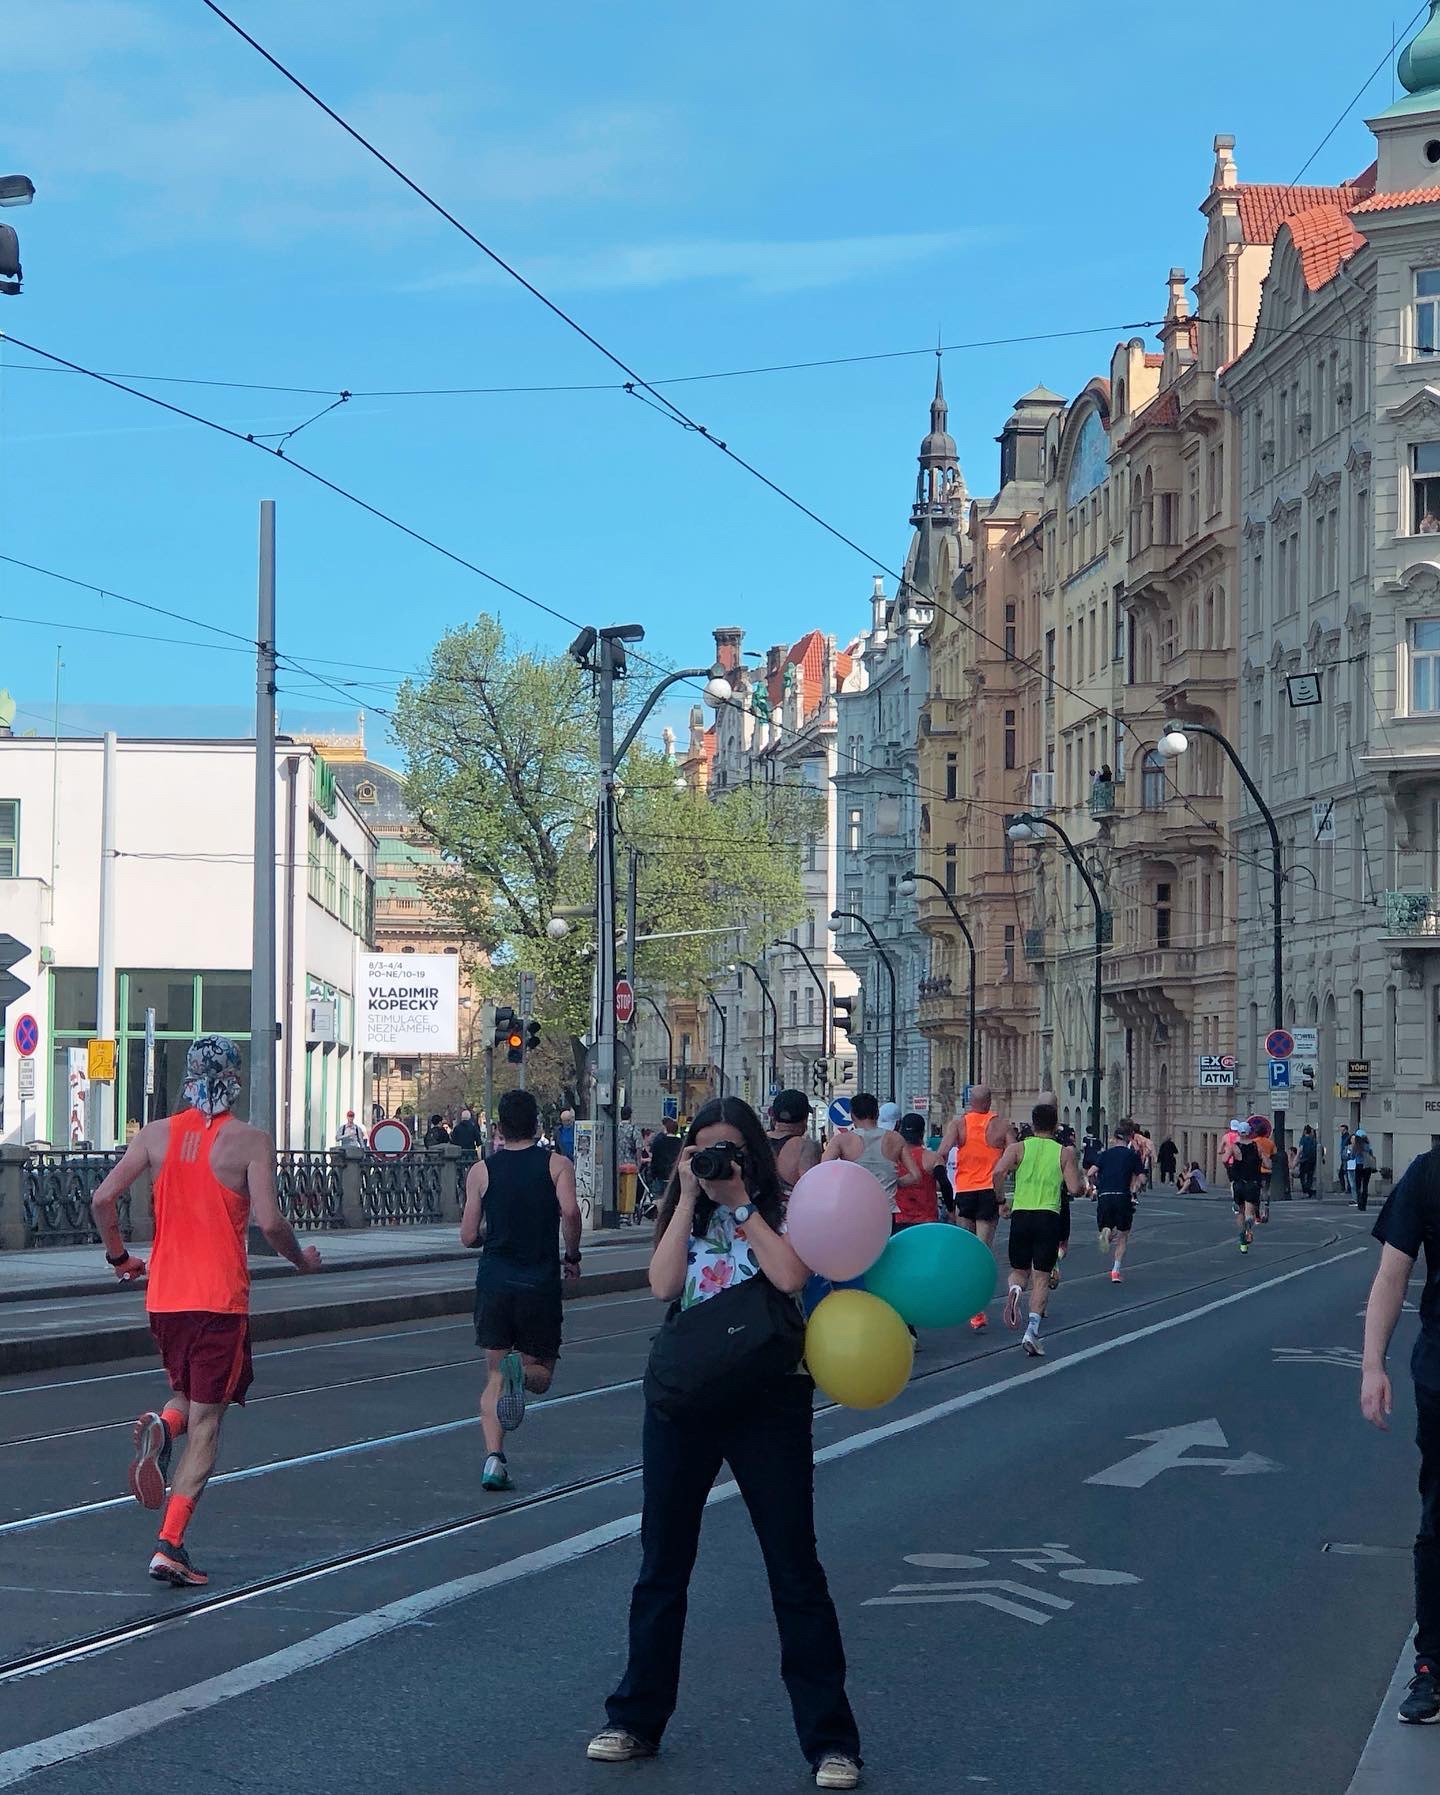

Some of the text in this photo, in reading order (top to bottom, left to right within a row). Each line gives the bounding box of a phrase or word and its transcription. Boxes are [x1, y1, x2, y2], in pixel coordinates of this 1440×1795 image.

[616, 994, 631, 1009] STOP
[368, 1014, 429, 1024] STIMULACE
[368, 1033, 397, 1043] POLE
[1273, 1063, 1286, 1080] P
[1204, 1073, 1231, 1083] ATM
